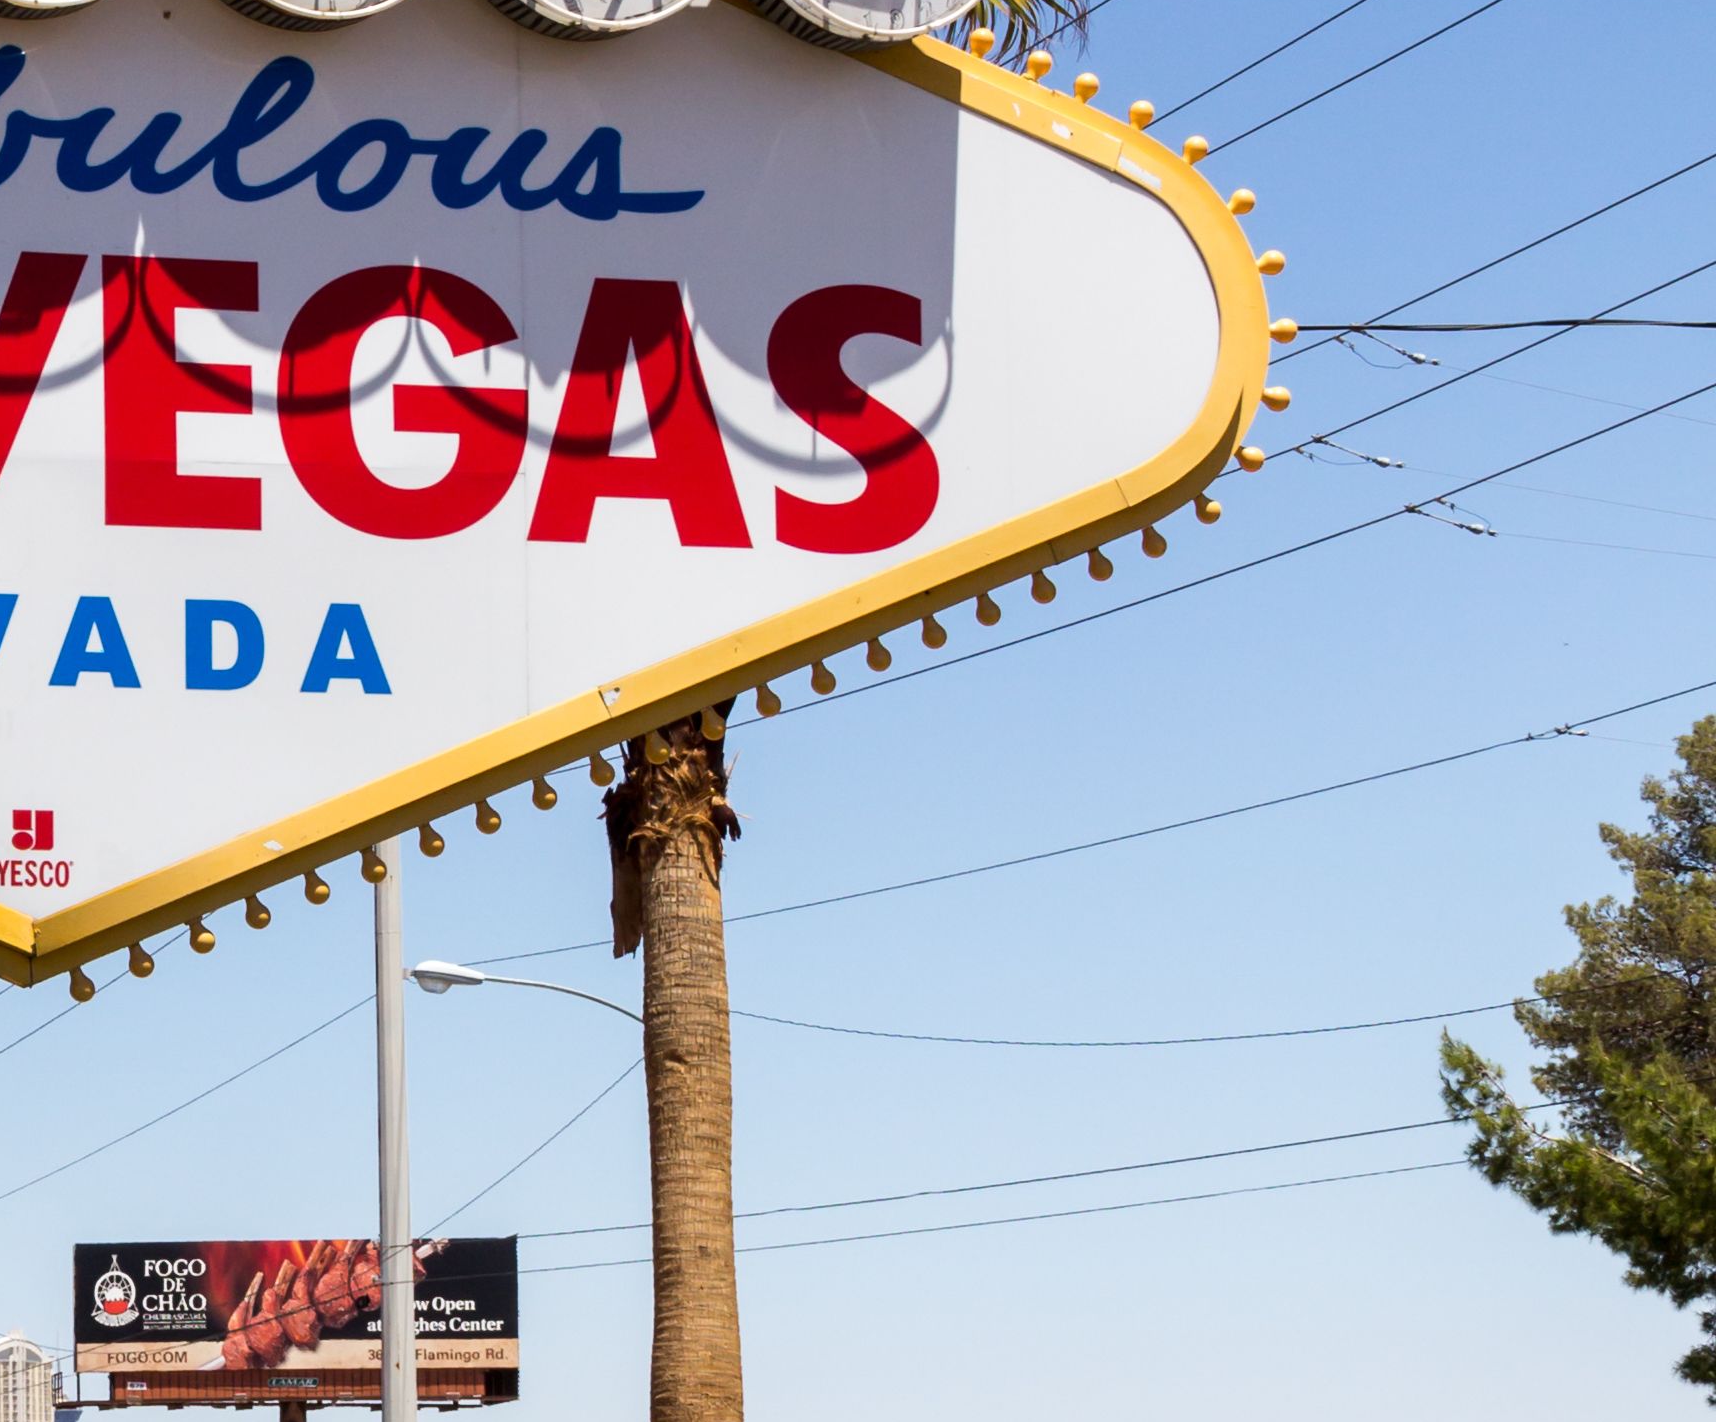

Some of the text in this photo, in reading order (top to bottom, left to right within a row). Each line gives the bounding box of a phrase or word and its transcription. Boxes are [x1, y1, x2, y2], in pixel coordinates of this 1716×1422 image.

[144, 1258, 207, 1277] FOGO
[163, 1278, 186, 1293] DE
[432, 1296, 476, 1315] Open
[367, 1317, 504, 1335] at ghes Center
[107, 1351, 188, 1364] FOGO.COM
[368, 1348, 509, 1362] 36 Flamingo Rd.
